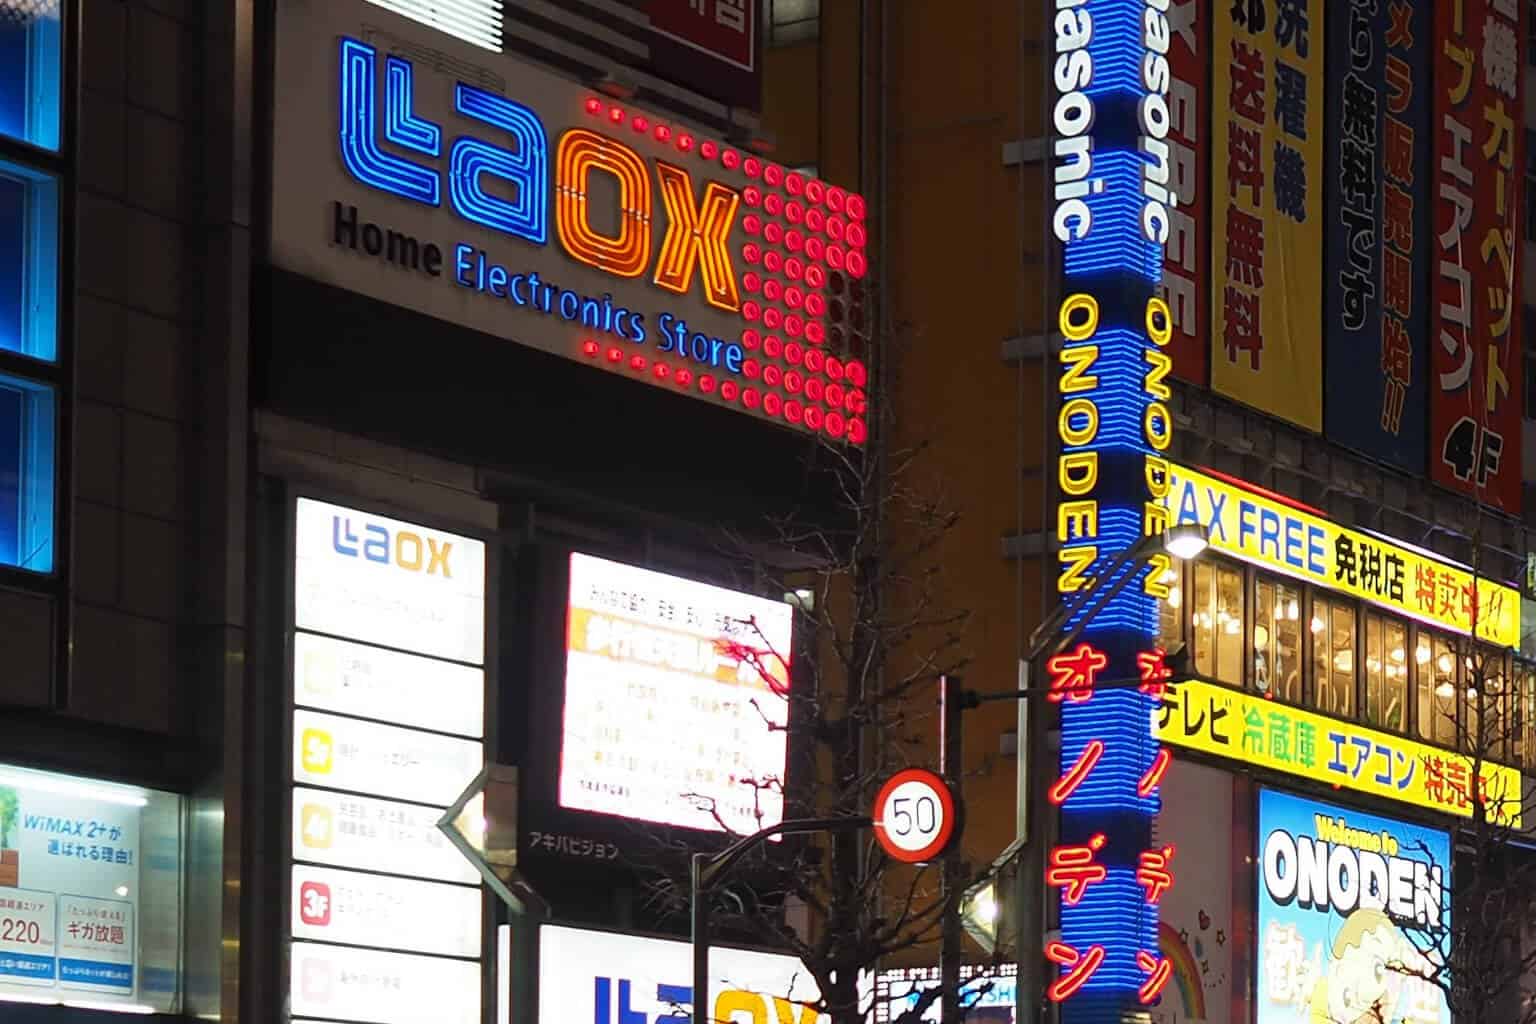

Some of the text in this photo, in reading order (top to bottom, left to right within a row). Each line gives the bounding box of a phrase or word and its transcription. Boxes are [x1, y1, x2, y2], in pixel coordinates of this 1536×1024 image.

[1053, 0, 1103, 245] asonic
[1143, 0, 1177, 245] asonic
[333, 201, 745, 376] Home Electronics Store
[1057, 292, 1098, 595] ONODEN
[1143, 297, 1173, 599] ONODEN
[1442, 416, 1504, 489] 4F
[1238, 499, 1326, 575] FREE
[1334, 533, 1406, 604] 免税店
[1156, 685, 1231, 746] テレビ
[1242, 703, 1317, 769] 冷蔵庫
[1327, 731, 1416, 791] エアコン
[24, 812, 84, 840] WiMAX
[893, 796, 936, 836] 50
[1046, 645, 1108, 1002] オノデン
[1135, 648, 1175, 1003] オノデン
[1313, 812, 1399, 856] Welcome to
[303, 889, 329, 920] 3F
[1263, 828, 1443, 930] ONODEN
[67, 921, 125, 946] ギガ放題
